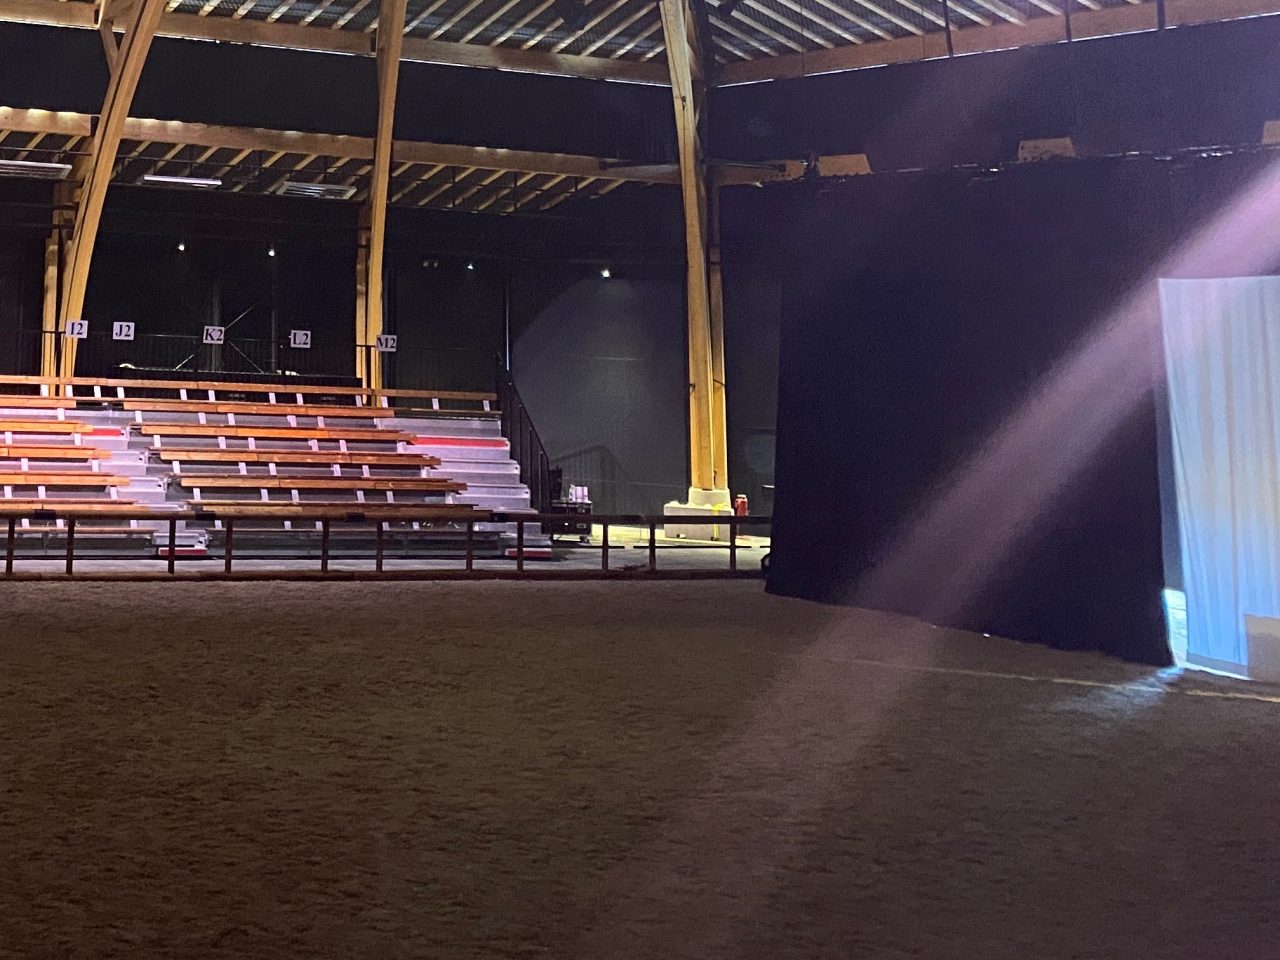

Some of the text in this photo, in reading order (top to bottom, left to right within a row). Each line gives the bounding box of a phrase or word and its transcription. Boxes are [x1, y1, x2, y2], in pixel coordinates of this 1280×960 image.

[70, 322, 83, 335] I2
[115, 324, 131, 338] J2
[204, 328, 223, 342] K2
[292, 332, 309, 346] L2
[376, 336, 396, 349] M2
